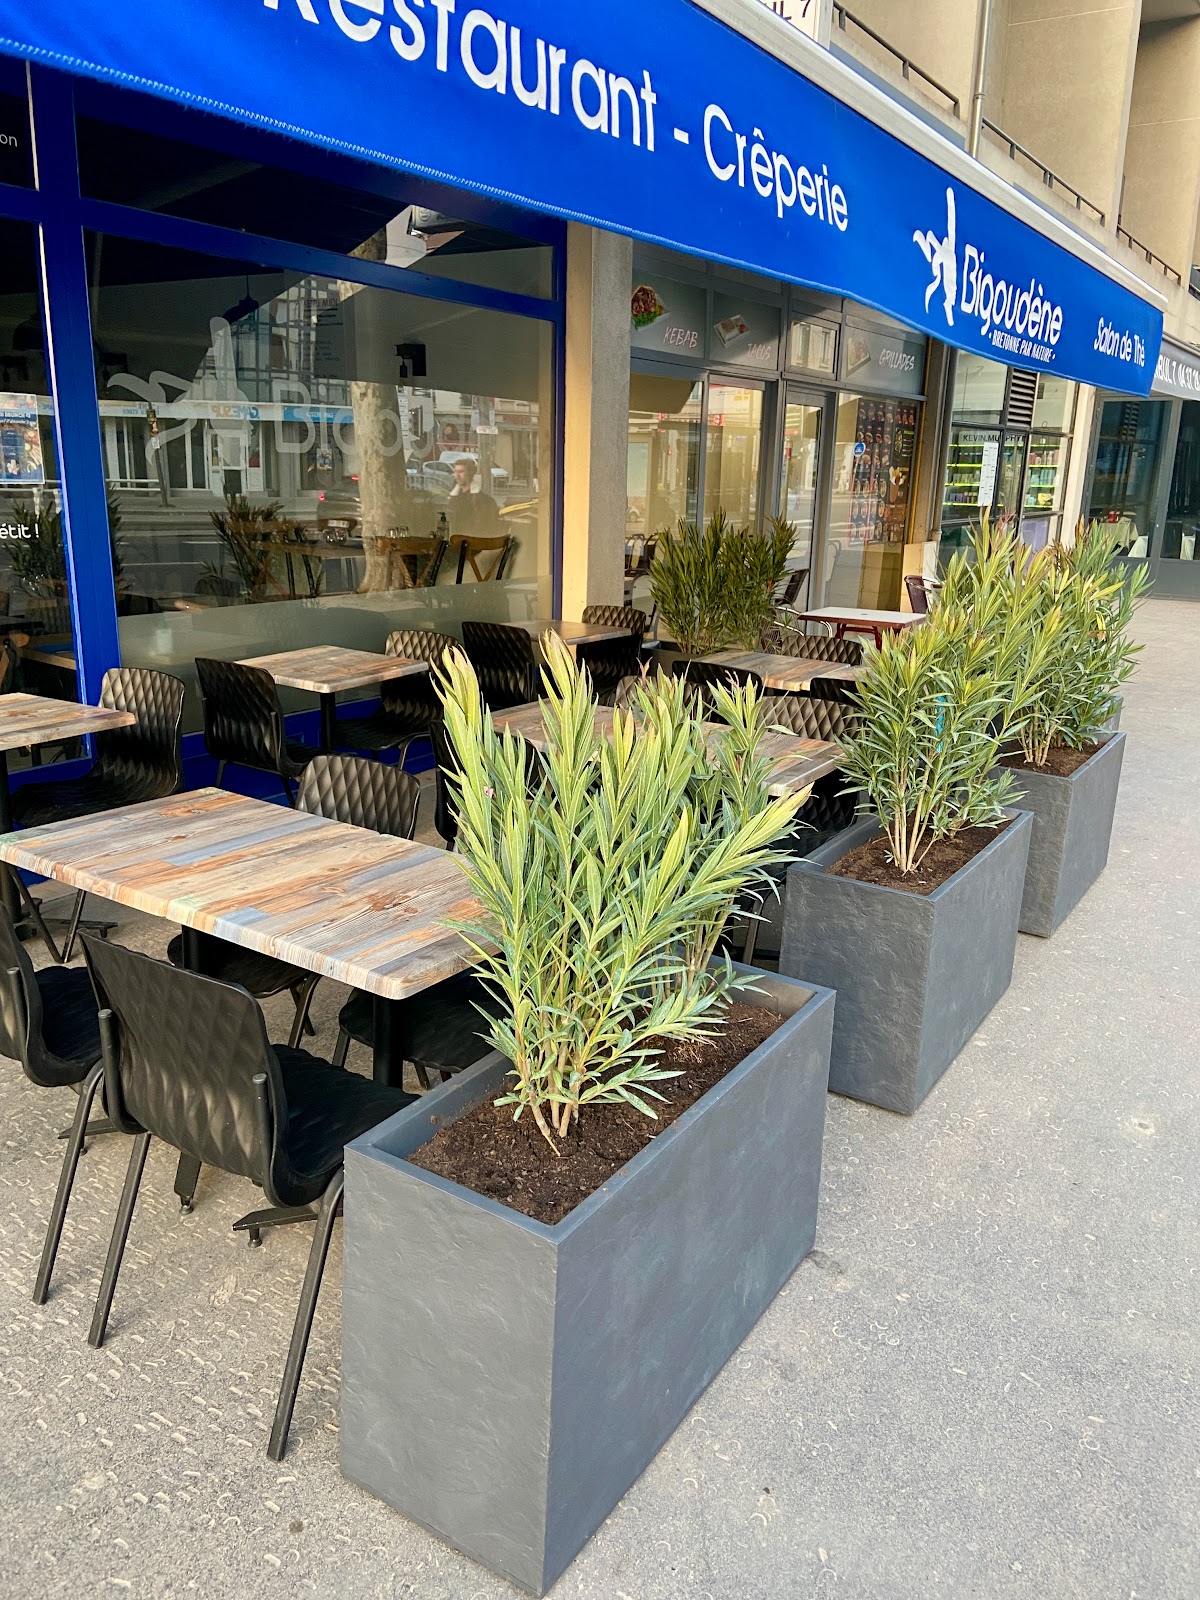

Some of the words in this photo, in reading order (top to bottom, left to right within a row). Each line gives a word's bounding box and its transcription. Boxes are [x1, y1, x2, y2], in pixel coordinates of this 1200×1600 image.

[703, 103, 849, 232] Crêperie
[960, 243, 1063, 346] Bigoudène
[663, 326, 698, 349] KEBAB
[747, 343, 771, 361] TACOS
[992, 329, 1021, 354] BRETONNE
[1019, 339, 1033, 357] PAR
[1031, 343, 1053, 363] NATURE
[1093, 316, 1120, 358] Salon
[1120, 329, 1132, 362] de
[1133, 334, 1145, 367] Thé
[879, 348, 915, 372] GRILLADES
[962, 433, 1024, 443] KEVIN.MUPHY
